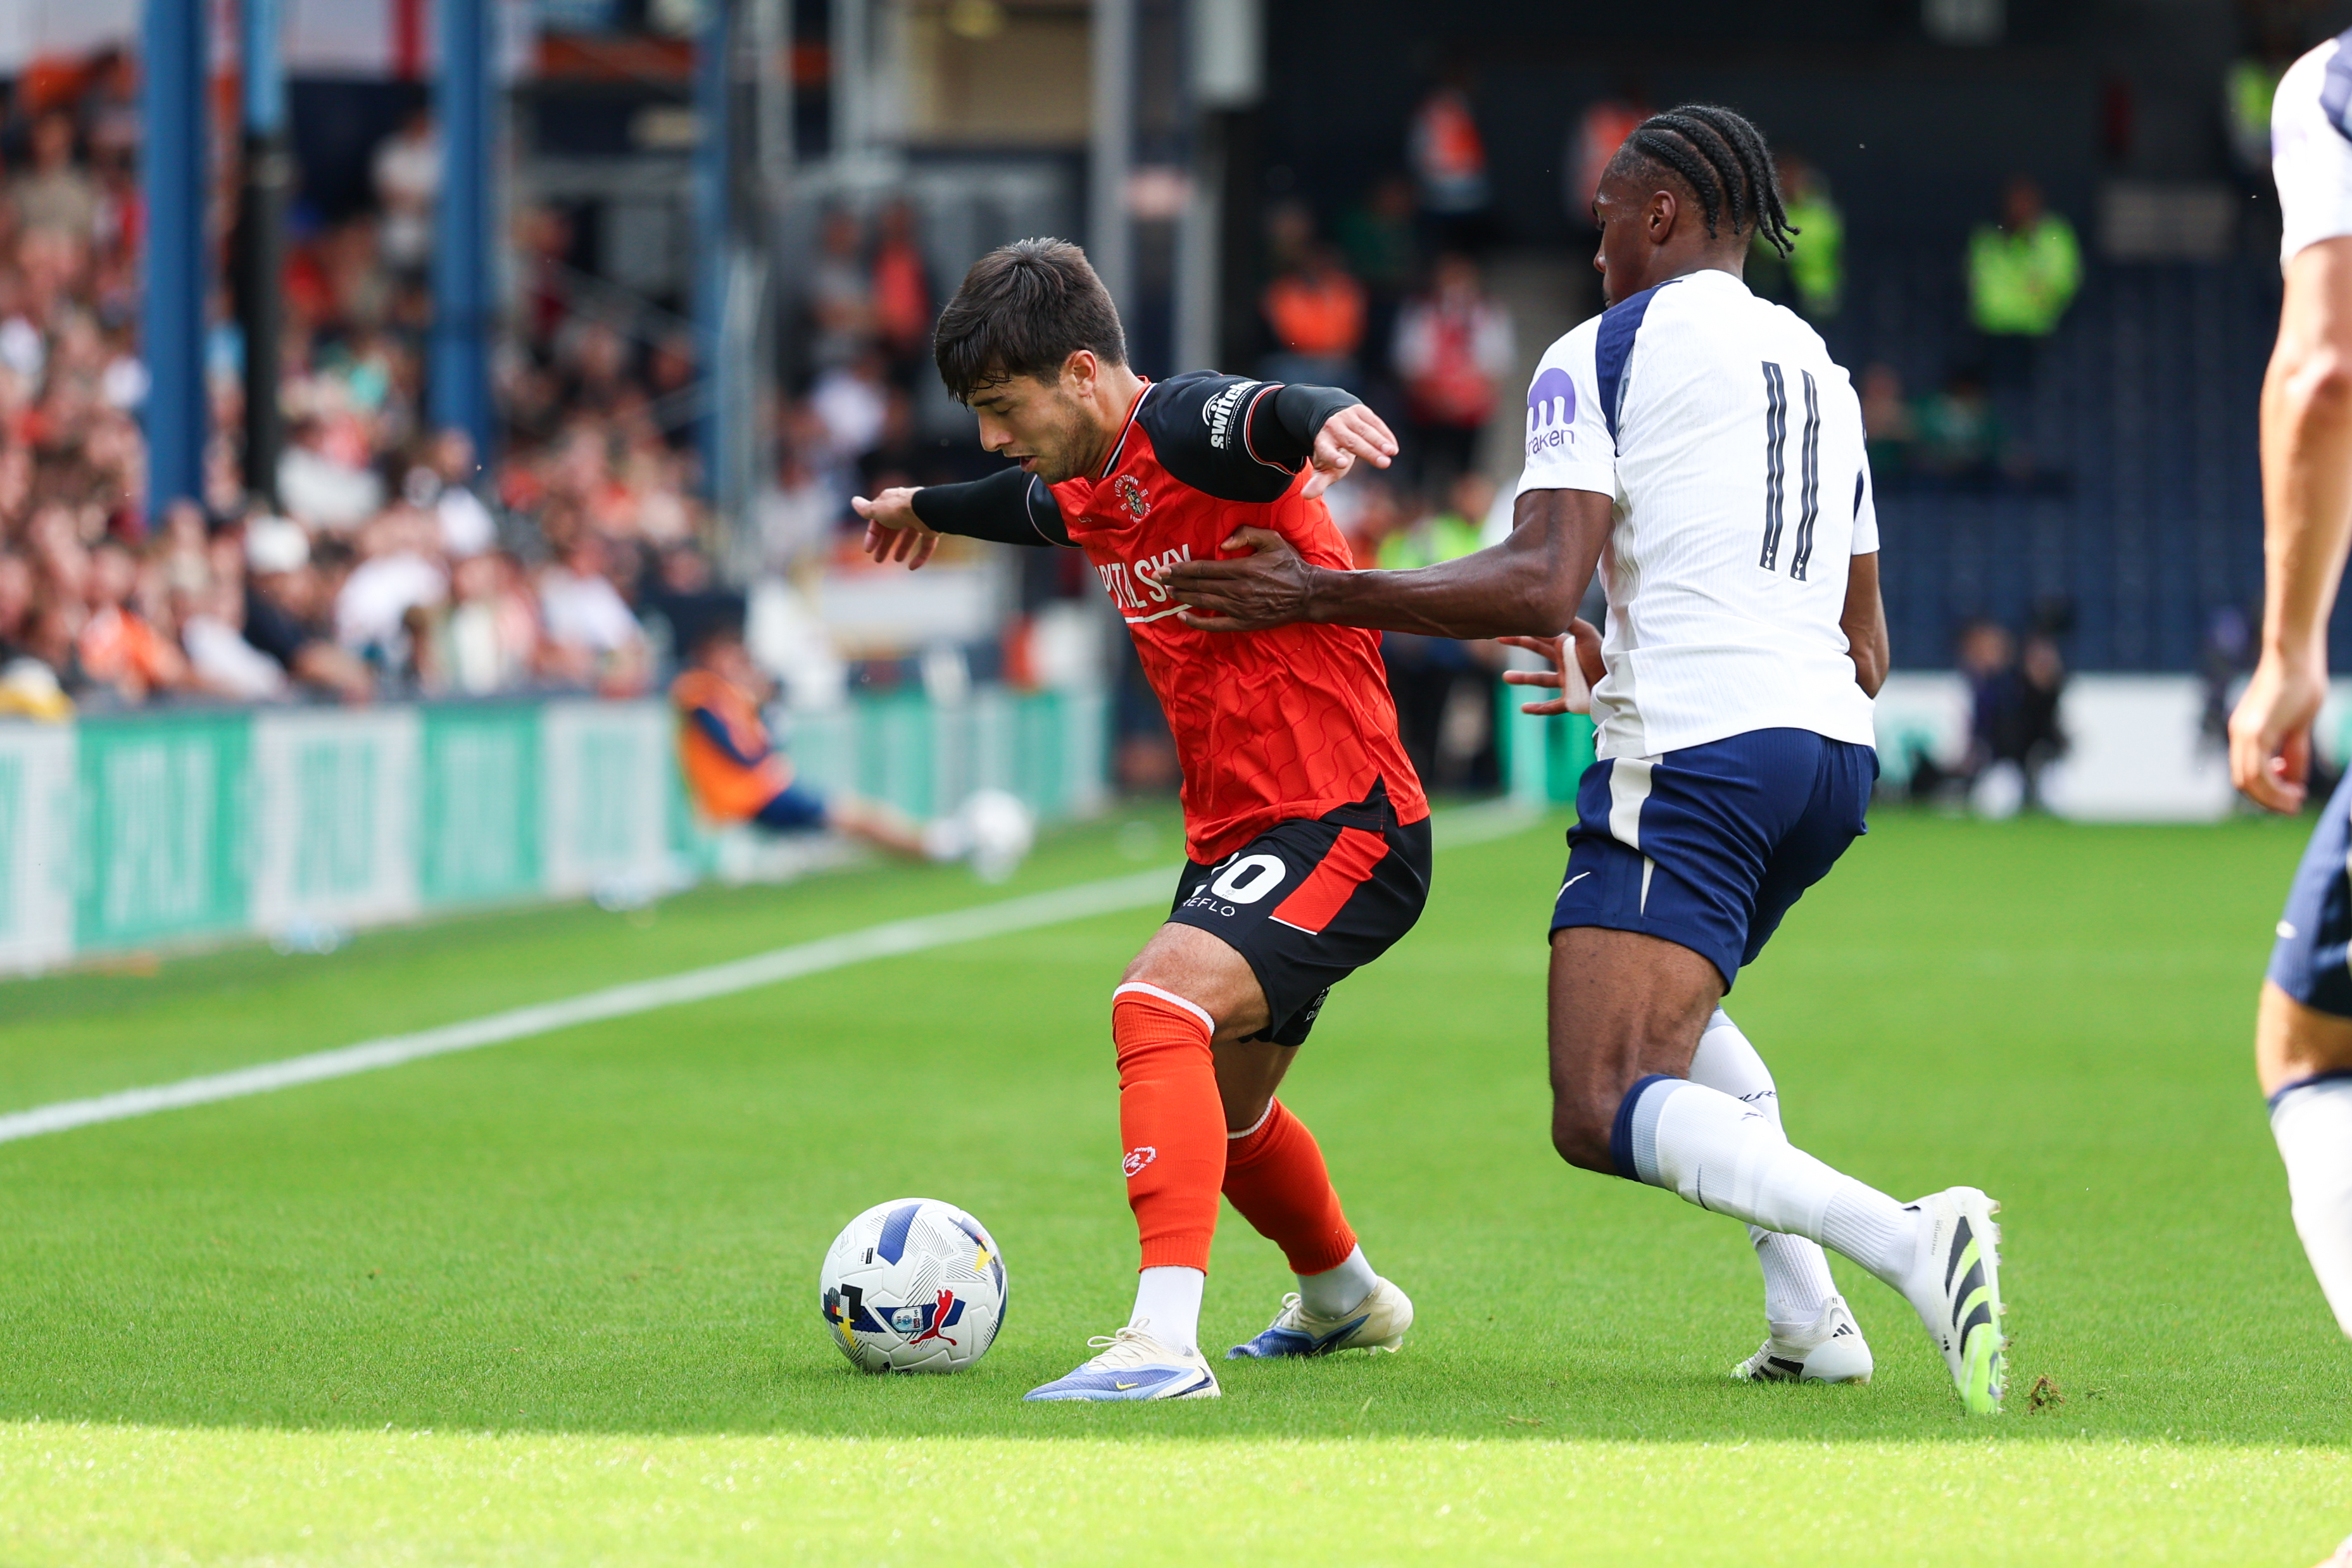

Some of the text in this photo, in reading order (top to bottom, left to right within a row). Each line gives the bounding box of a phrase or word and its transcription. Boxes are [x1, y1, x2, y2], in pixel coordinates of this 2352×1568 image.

[1526, 429, 1575, 458] raken
[1121, 474, 1139, 486] TOWN
[1759, 360, 1821, 584] 11
